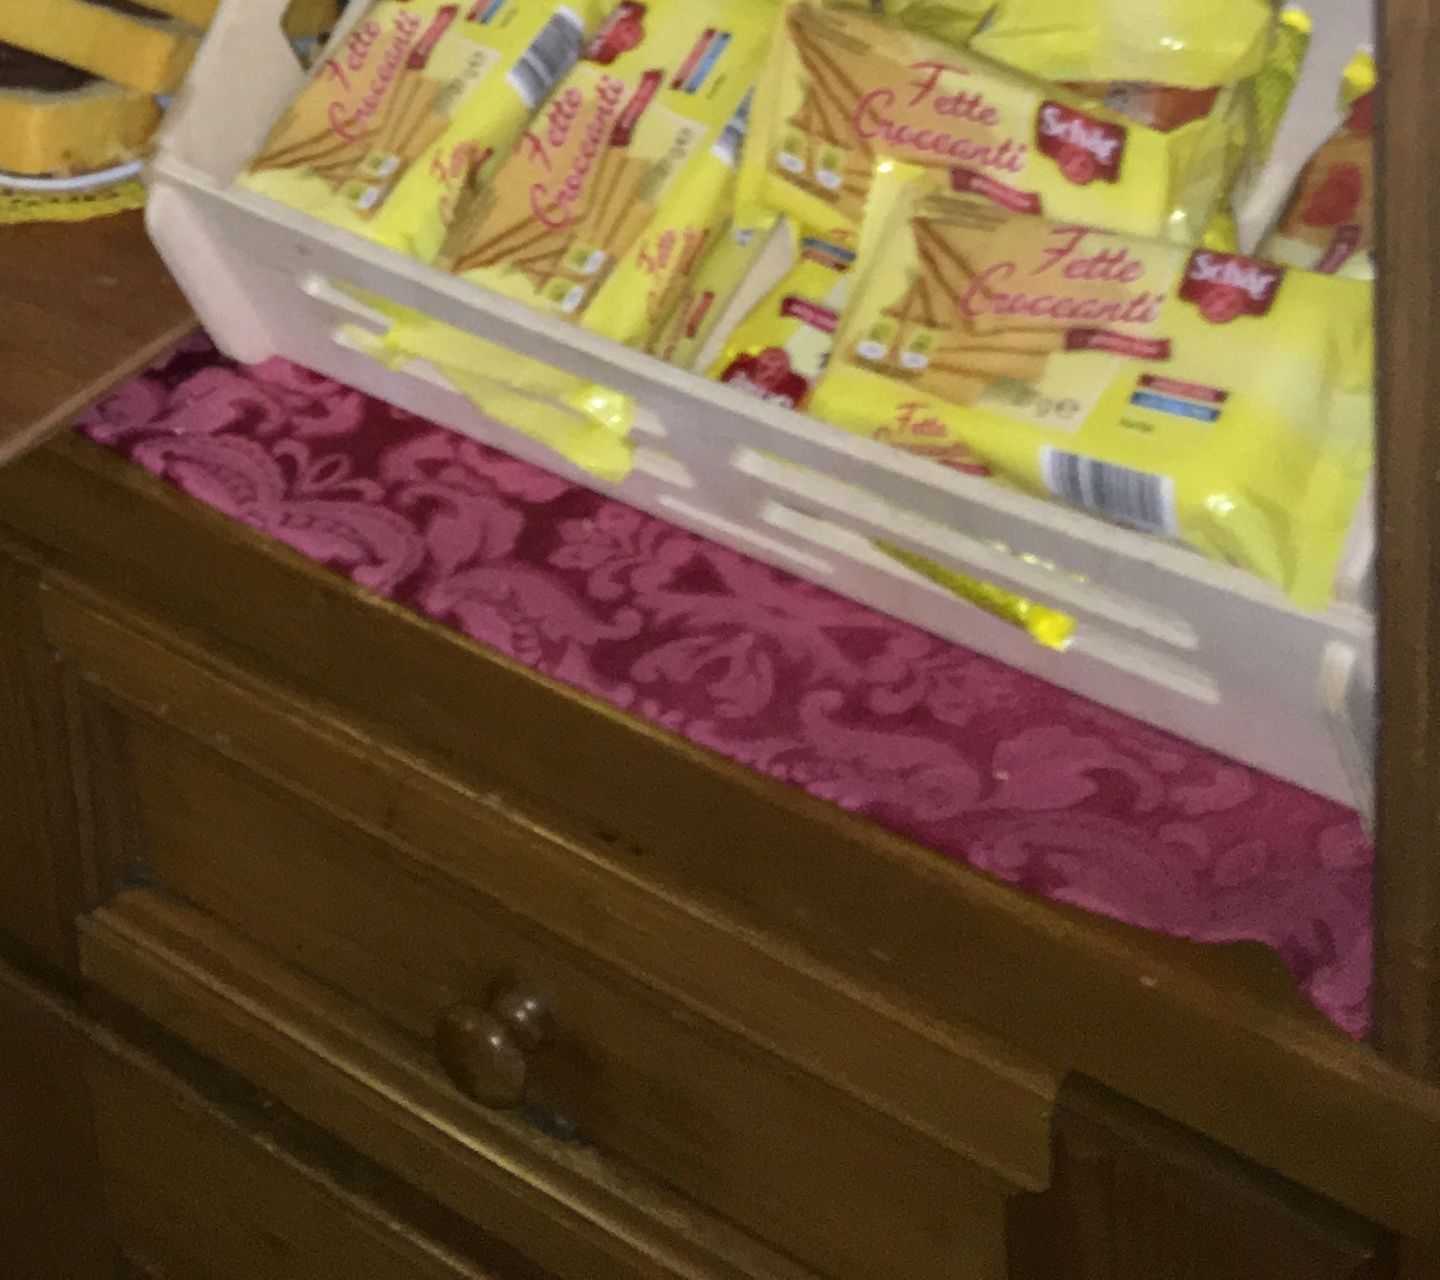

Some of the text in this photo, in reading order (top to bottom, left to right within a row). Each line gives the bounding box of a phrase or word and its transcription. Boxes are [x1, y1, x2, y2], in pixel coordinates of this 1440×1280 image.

[908, 60, 1000, 127] Fette
[513, 86, 582, 172] Fette
[1028, 225, 1144, 284] Fette
